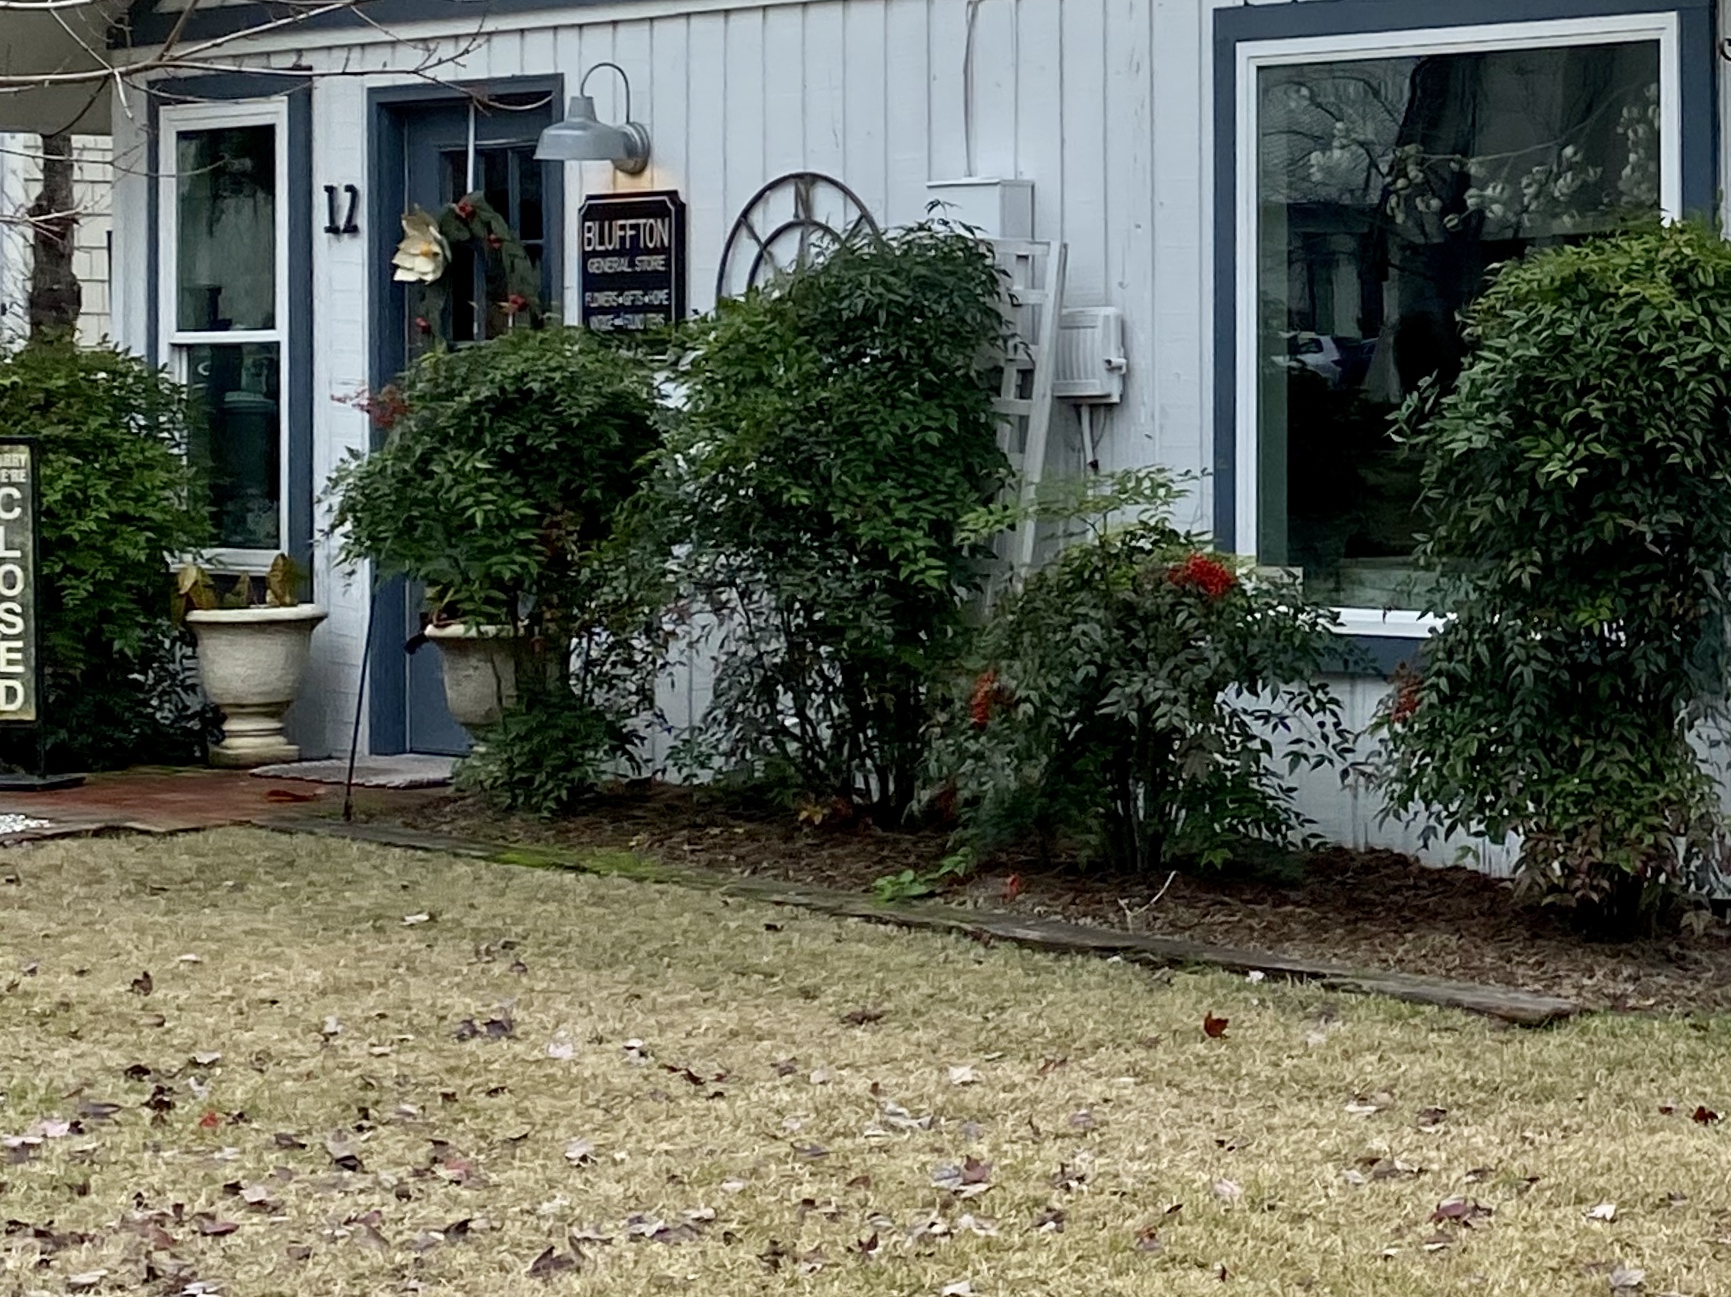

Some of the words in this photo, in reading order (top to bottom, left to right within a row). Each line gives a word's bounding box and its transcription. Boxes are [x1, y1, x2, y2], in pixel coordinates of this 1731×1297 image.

[323, 184, 359, 235] 12
[584, 217, 670, 252] BLUFFTON
[587, 256, 633, 274] GENERAL
[635, 254, 667, 271] STORE
[0, 487, 25, 711] CLOSED
